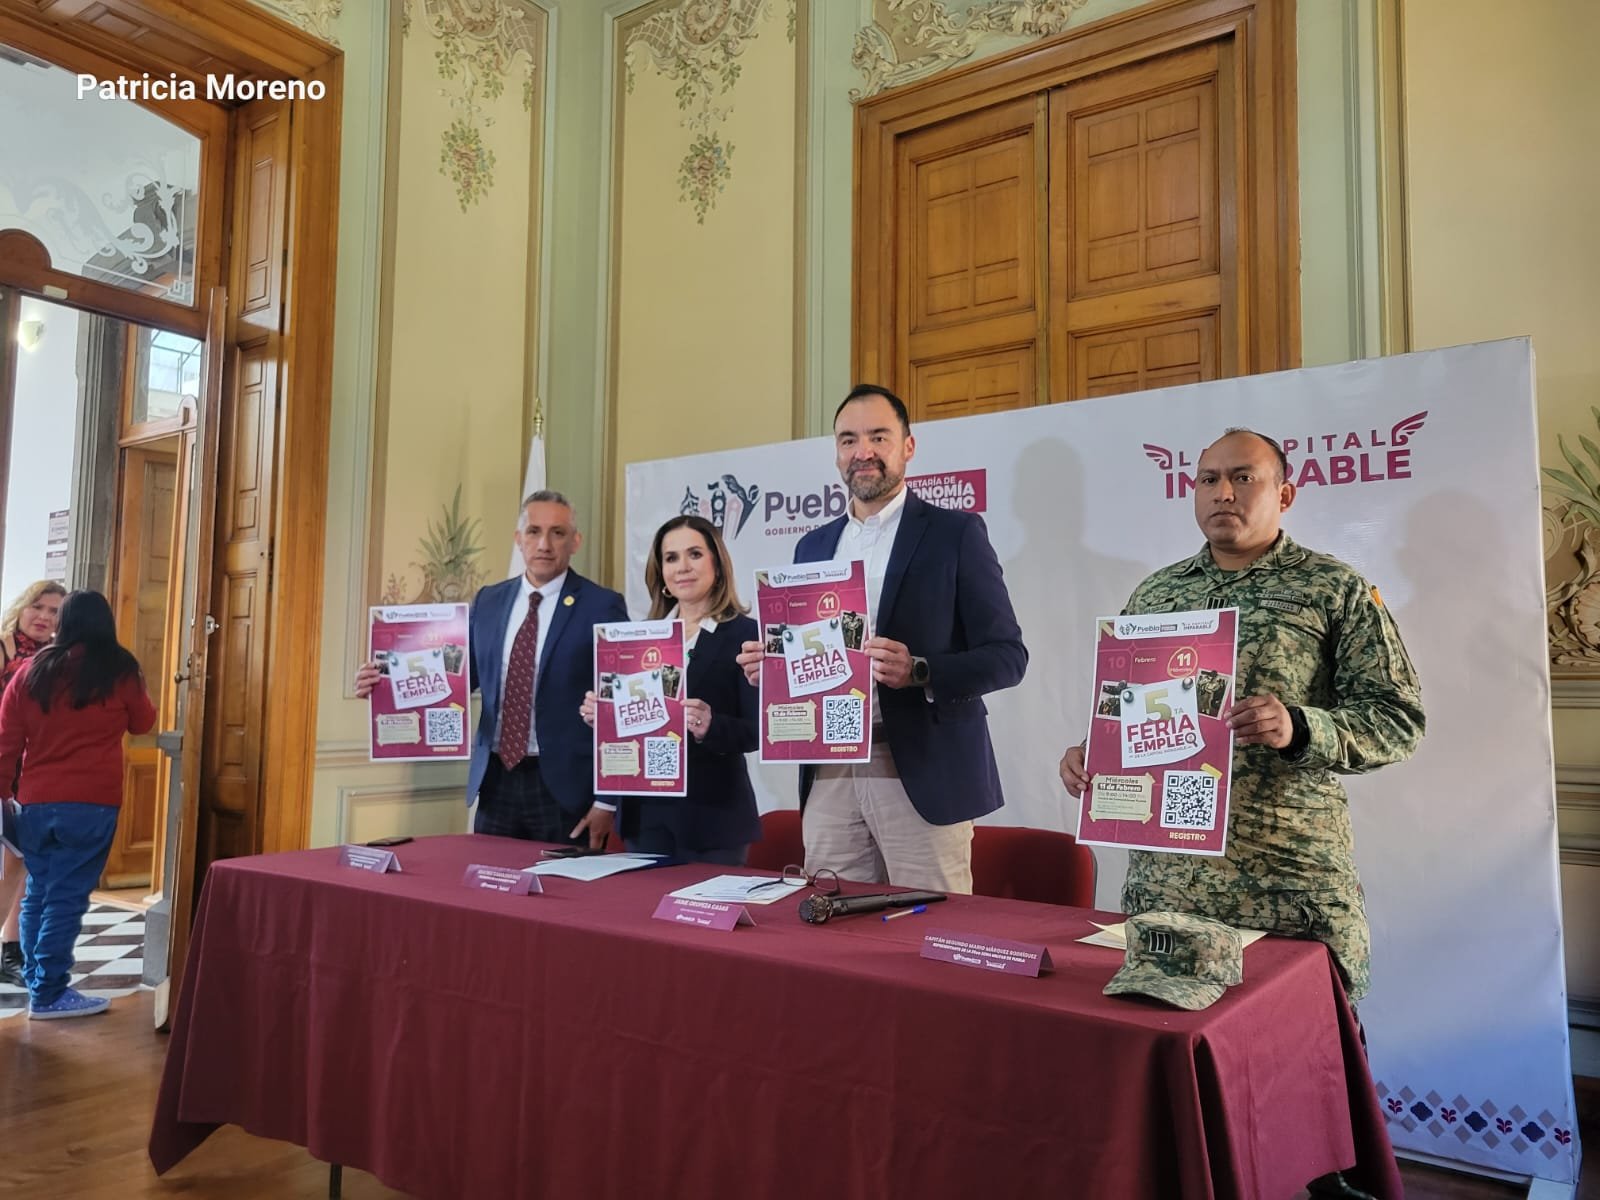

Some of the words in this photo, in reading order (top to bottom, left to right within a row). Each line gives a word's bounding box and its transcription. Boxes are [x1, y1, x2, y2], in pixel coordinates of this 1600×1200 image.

[1284, 429, 1387, 455] PITAL
[906, 476, 942, 488] RETARÍA
[944, 476, 956, 484] DE
[1165, 449, 1412, 499] IMABLE
[912, 480, 975, 499] ONOMÍA
[765, 483, 853, 522] Pueb
[925, 495, 976, 510] ISMO
[765, 525, 812, 536] GOBIERNO
[768, 602, 783, 614] 10
[823, 597, 834, 609] 11
[802, 628, 825, 656] 5
[647, 652, 658, 662] 11
[791, 649, 844, 676] FERIA
[1108, 656, 1126, 668] 10
[1176, 653, 1191, 666] 11
[396, 673, 444, 692] FERIA
[629, 679, 646, 704] 5
[619, 697, 663, 718] FERIA
[1144, 688, 1172, 722] 5
[1104, 722, 1118, 734] 17
[1126, 714, 1196, 742] FERIA
[1170, 832, 1206, 841] REGISTRO
[925, 936, 946, 944] CAPITÁN
[946, 939, 968, 948] SEGUNDO
[986, 946, 1009, 955] MÁRQUEZ
[1010, 950, 1038, 960] RODRÍGUEZ
